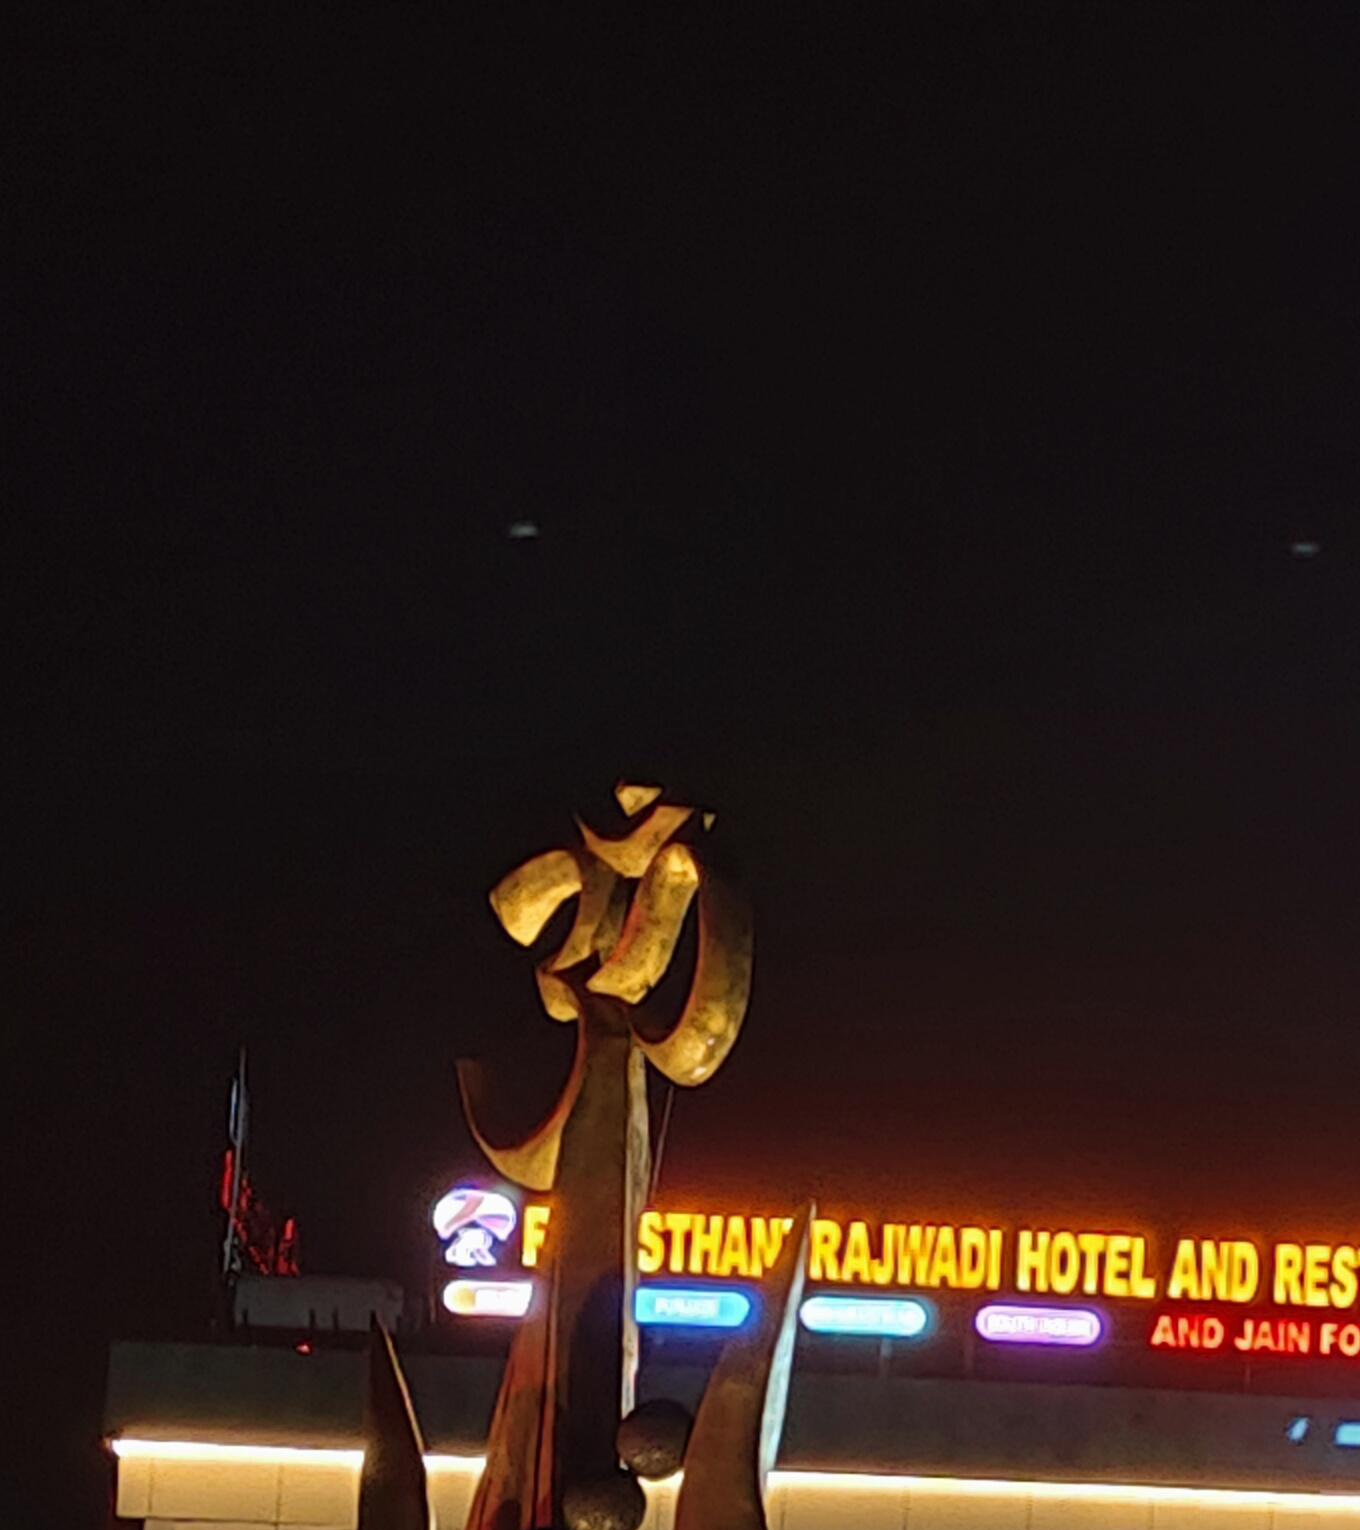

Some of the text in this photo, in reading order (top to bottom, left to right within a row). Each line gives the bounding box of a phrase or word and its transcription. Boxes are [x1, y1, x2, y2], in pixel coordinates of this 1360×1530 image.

[810, 1219, 1000, 1289] RAJWADI
[1017, 1230, 1155, 1297] HOTEL
[1168, 1239, 1259, 1302] AND
[1152, 1316, 1224, 1349] AND
[1234, 1320, 1310, 1354] JAIN
